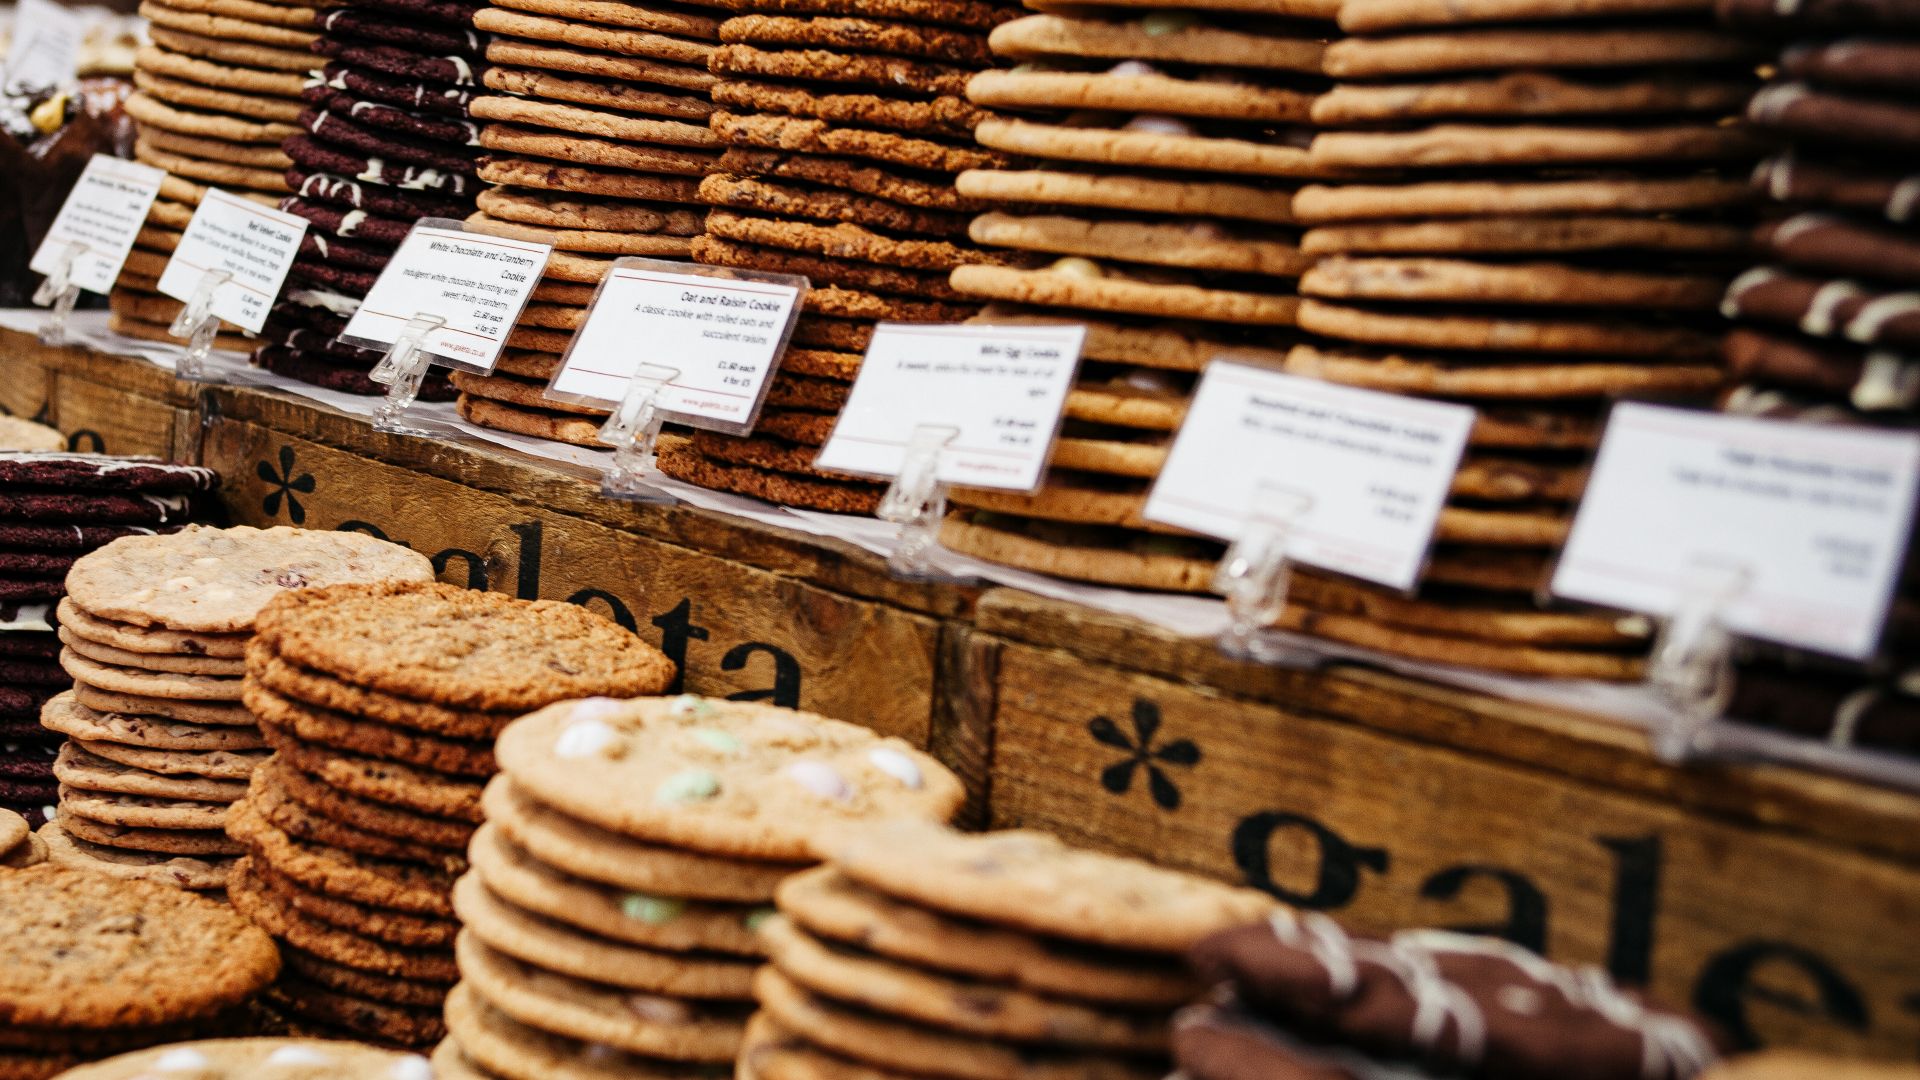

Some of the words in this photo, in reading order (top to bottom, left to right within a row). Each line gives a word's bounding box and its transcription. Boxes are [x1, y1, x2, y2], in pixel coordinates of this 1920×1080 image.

[247, 219, 260, 231] Red
[258, 224, 276, 237] Velvet
[274, 230, 292, 243] Cookie
[429, 241, 450, 252] White
[450, 244, 484, 257] Chocolate
[483, 251, 499, 260] and
[498, 252, 534, 268] Cranberry
[500, 269, 526, 282] Cookie
[430, 273, 447, 282] white
[447, 277, 477, 287] chocolate
[476, 281, 504, 295] bursting
[503, 287, 518, 296] with
[441, 290, 460, 299] sweet
[680, 291, 698, 302] Oat
[698, 295, 718, 305] and
[718, 295, 747, 308] Raisin
[748, 298, 780, 312] Cookie
[489, 314, 503, 322] each
[633, 303, 641, 311] A
[641, 304, 667, 316] classic
[666, 308, 694, 319] cookie
[695, 311, 712, 320] with
[714, 313, 738, 324] rolled
[739, 317, 756, 326] oats
[758, 320, 775, 328] and
[479, 324, 489, 332] for
[701, 329, 741, 341] succulent
[738, 365, 756, 373] each
[729, 376, 740, 385] for
